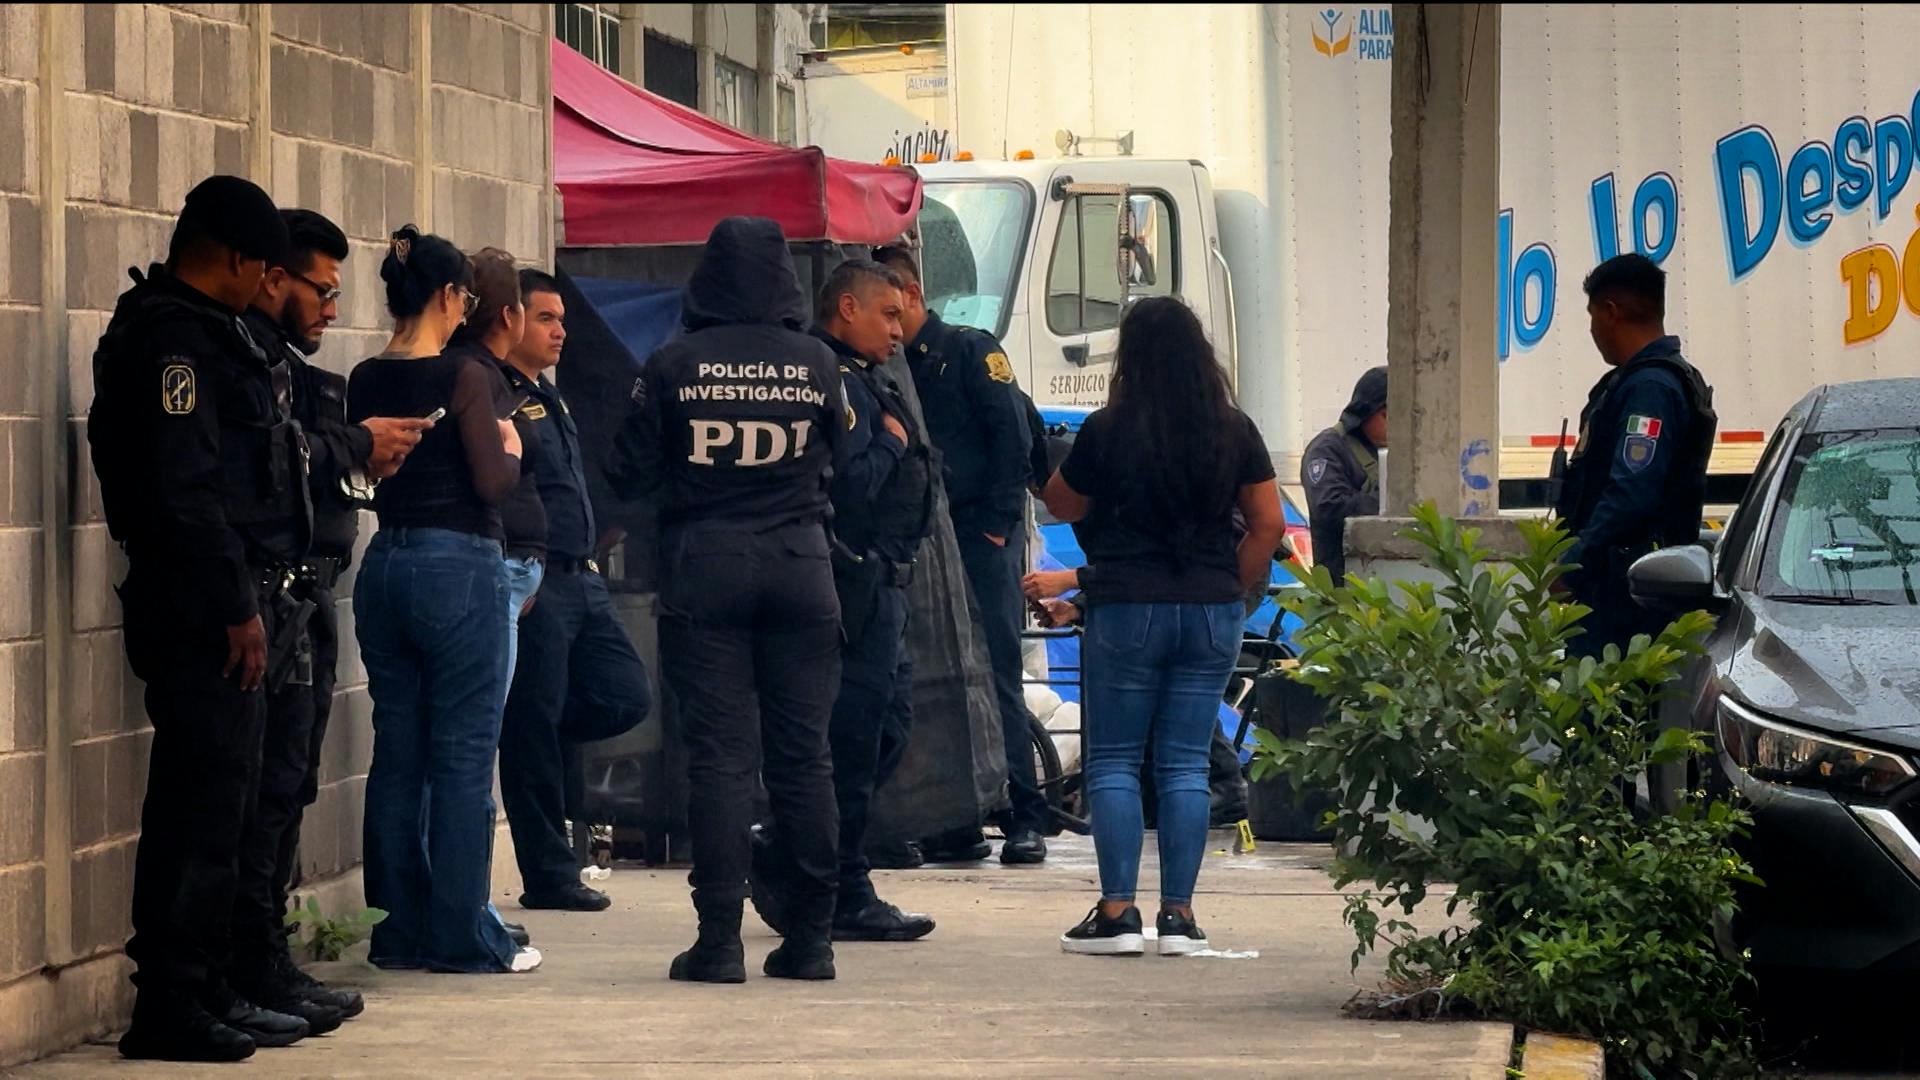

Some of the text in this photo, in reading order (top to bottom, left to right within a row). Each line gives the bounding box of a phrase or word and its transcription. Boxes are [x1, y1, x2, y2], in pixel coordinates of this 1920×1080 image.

[1712, 88, 1920, 285] Desp
[698, 361, 809, 381] POLICÍA DE
[1049, 372, 1105, 395] SERVICIO
[678, 385, 826, 406] INVESTIGACIÓN
[687, 419, 812, 467] PDI
